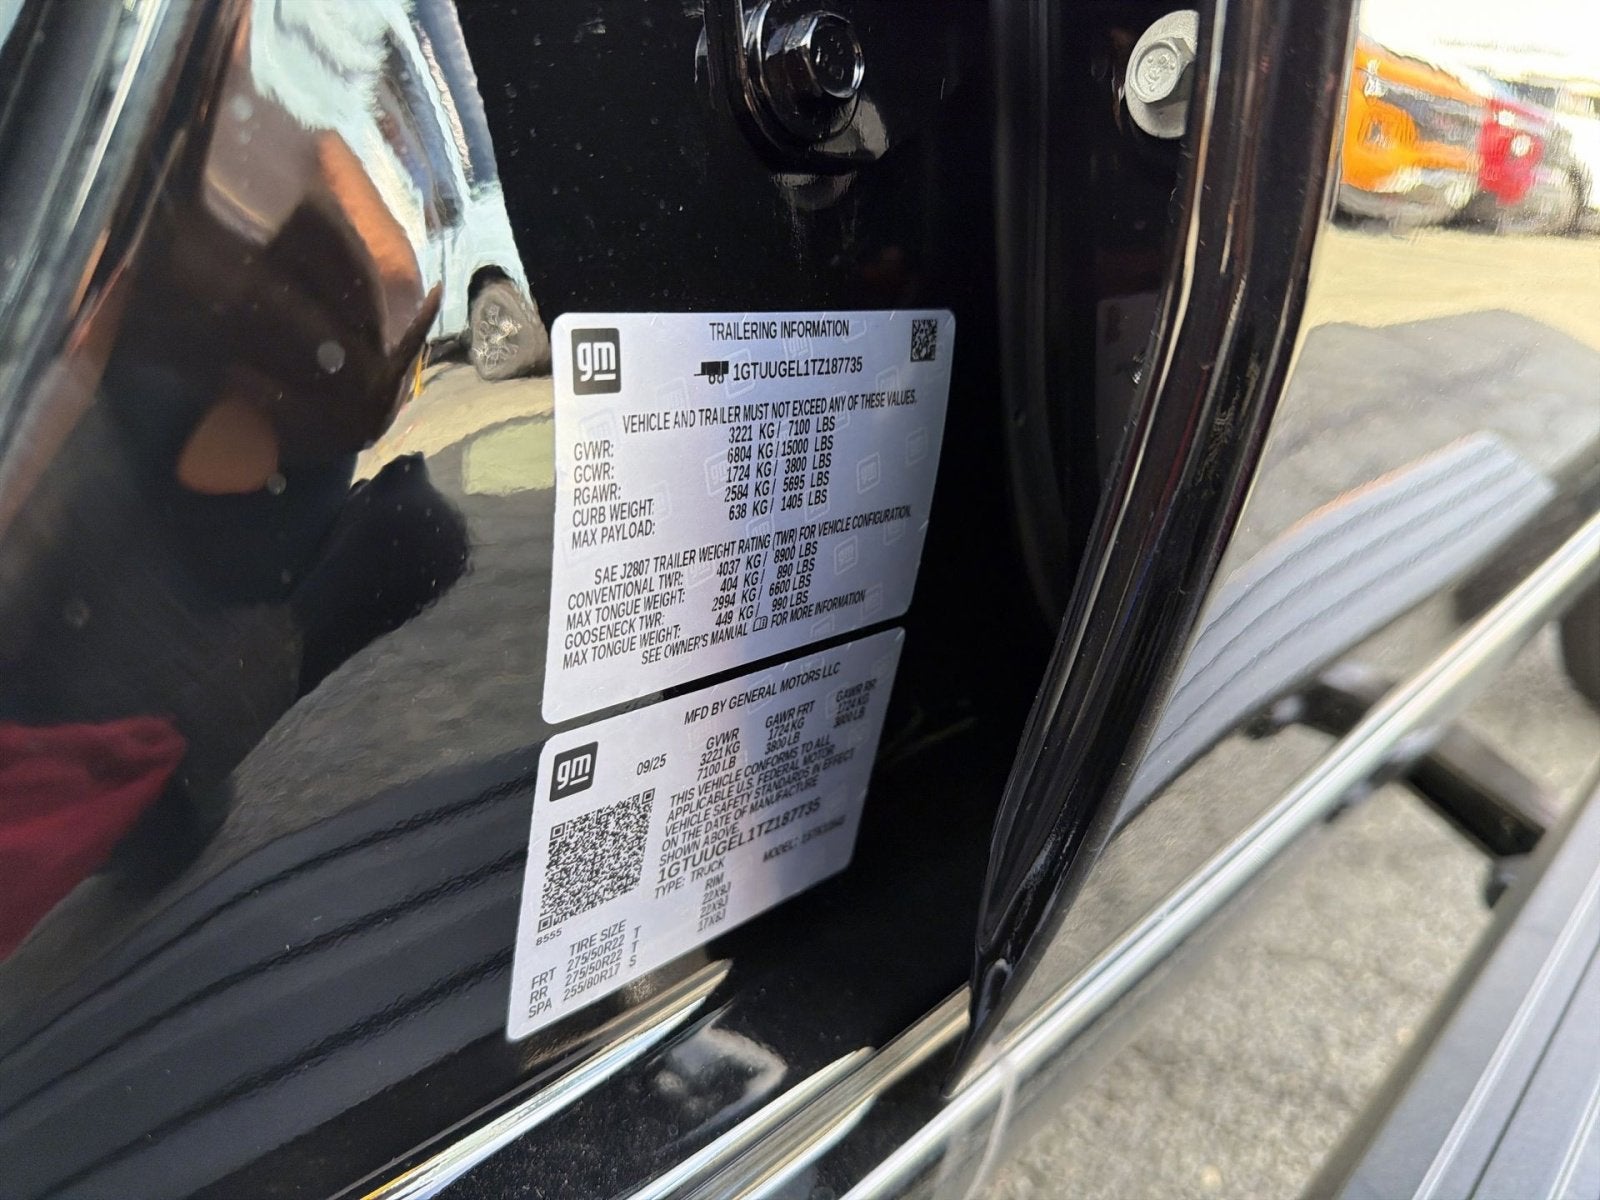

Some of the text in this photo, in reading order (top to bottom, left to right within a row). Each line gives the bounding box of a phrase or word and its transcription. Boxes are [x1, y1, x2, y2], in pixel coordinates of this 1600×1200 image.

[709, 319, 849, 340] TRAILERING INFORMATION
[733, 356, 863, 381] 1GTUUGEL1TZ187735
[574, 440, 614, 462] GVWR:
[729, 425, 752, 443] 3221
[789, 419, 810, 436] 7100
[817, 416, 835, 433] LBS
[623, 412, 670, 434] VEHICLE
[673, 410, 696, 428] AND
[698, 405, 740, 426] TRAILER
[743, 403, 769, 421] MUST
[772, 401, 789, 418] NOT
[793, 398, 827, 416] EXCEED
[829, 396, 847, 413] ANY
[848, 395, 859, 411] OF
[860, 392, 885, 408] THESE
[574, 462, 614, 484] GCWR:
[728, 446, 751, 464] 6804
[815, 436, 834, 451] LBS
[574, 483, 621, 506] RGAWR:
[726, 466, 750, 483] 1724
[784, 456, 806, 474] 3800
[813, 452, 832, 470] LBS
[572, 529, 597, 550] MAX
[601, 520, 655, 546] PAYLOAD:
[729, 504, 746, 520] 638
[781, 494, 802, 511] 1405
[808, 489, 827, 506] LBS
[573, 506, 605, 528] CURB
[610, 499, 654, 522] WEIGHT:
[724, 485, 748, 503] 2584
[783, 475, 804, 492] 5695
[811, 471, 829, 488] LBS
[568, 580, 654, 610] CONVENTIONAL
[659, 571, 684, 590] TWR:
[717, 558, 741, 576] 4037
[774, 546, 795, 564] 8900
[799, 542, 818, 558] LBS
[595, 565, 618, 585] SAE
[620, 559, 650, 580] J2807
[654, 549, 696, 572] TRAILER
[699, 542, 736, 563] WEIGHT
[739, 536, 771, 554] RATING
[772, 529, 797, 550] (TWR)
[799, 526, 815, 541] FOR
[818, 517, 851, 537] VEHICLE
[565, 617, 636, 650] GOOSENECK
[640, 612, 665, 631] TWR:
[712, 593, 736, 611] 2994
[769, 580, 790, 596] 6600
[792, 574, 812, 591] LBS
[566, 610, 591, 631] MAX
[595, 598, 641, 626] TONGUE
[644, 588, 685, 612] WEIGHT:
[720, 576, 737, 593] 404
[777, 563, 793, 579] 890
[796, 558, 815, 575] LBS
[563, 649, 587, 670] MAX
[592, 636, 637, 662] TONGUE
[640, 624, 680, 648] WEIGHT:
[715, 611, 733, 628] 449
[772, 596, 788, 612] 990
[790, 591, 809, 608] LBS
[641, 590, 866, 665] SEE OWNER'S MANUAL FOR MORE INFORMATION
[685, 662, 841, 725] MFD BY GENERAL MOTORS LLC
[766, 700, 815, 728] GAWR FRT
[700, 741, 740, 766] 3221 KG
[706, 728, 739, 750] GVWR
[768, 717, 804, 740] 1724 KG
[788, 732, 800, 745] LB
[637, 753, 667, 776] 09/25
[666, 784, 735, 824] APPLICABLE
[758, 760, 800, 783] FEDERAL
[803, 744, 835, 766] MOTOR
[671, 734, 831, 807] THIS VEHICLE CONFORMS TO ALL
[697, 756, 736, 781] 7100 LB
[662, 775, 819, 852] ON THE DATE OF MANUFACTURE
[666, 747, 855, 837] VEHICLE SAFETY STANDARDS IN EFFECT
[657, 797, 821, 884] 1GTUUGEL1TZ187735
[660, 838, 701, 866] SHOWN
[655, 857, 725, 899] TYPE: TRUCK
[705, 873, 724, 891] RIM
[531, 967, 556, 989] FRT
[567, 934, 625, 972] 275/50R22
[634, 926, 642, 938] T
[536, 928, 562, 946] 8555
[569, 919, 627, 957] TIRE SIZE
[528, 999, 552, 1019] SPA
[563, 963, 621, 1002] 255/80R17
[629, 955, 636, 967] S
[529, 988, 548, 1004] RR
[565, 949, 623, 987] 275/50R22
[632, 940, 639, 953] T
